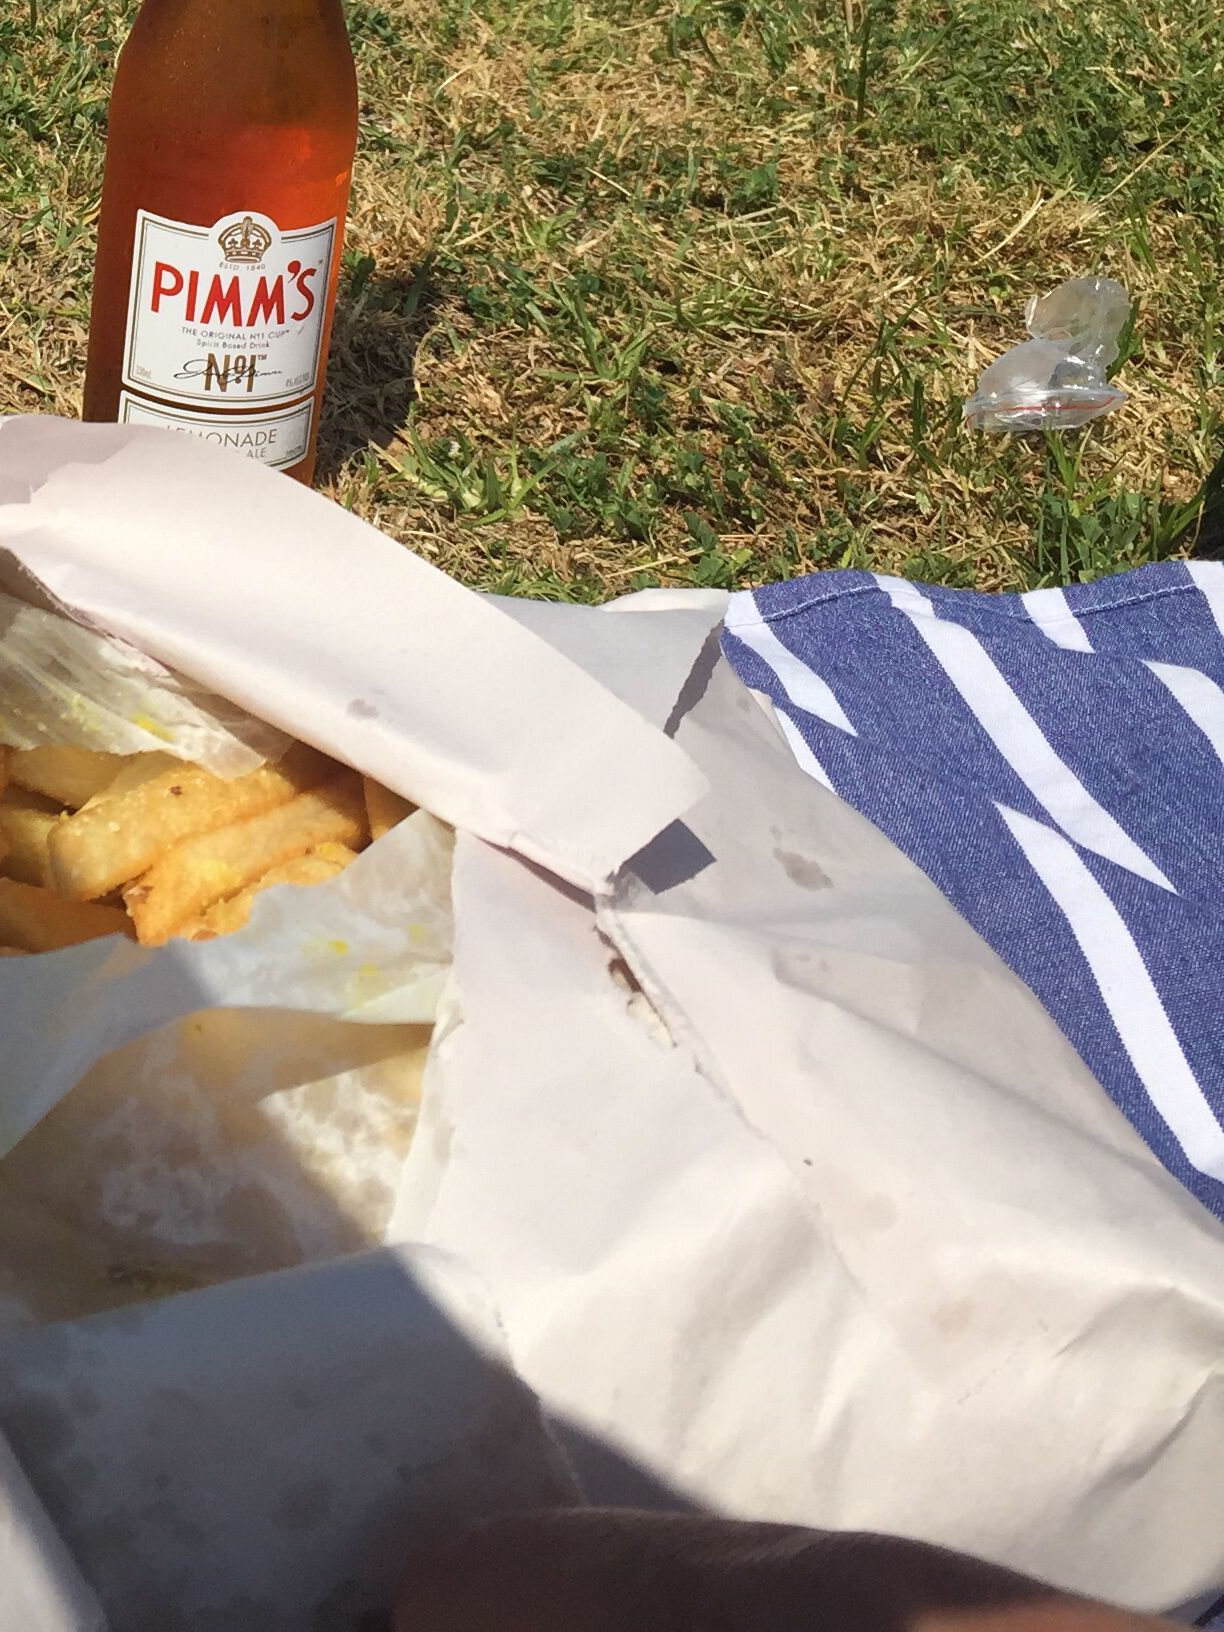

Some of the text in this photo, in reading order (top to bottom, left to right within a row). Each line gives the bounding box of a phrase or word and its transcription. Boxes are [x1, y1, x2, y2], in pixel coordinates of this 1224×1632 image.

[150, 260, 317, 327] PIMM'S
[181, 326, 197, 336] THE
[201, 330, 246, 340] ORIGINAL
